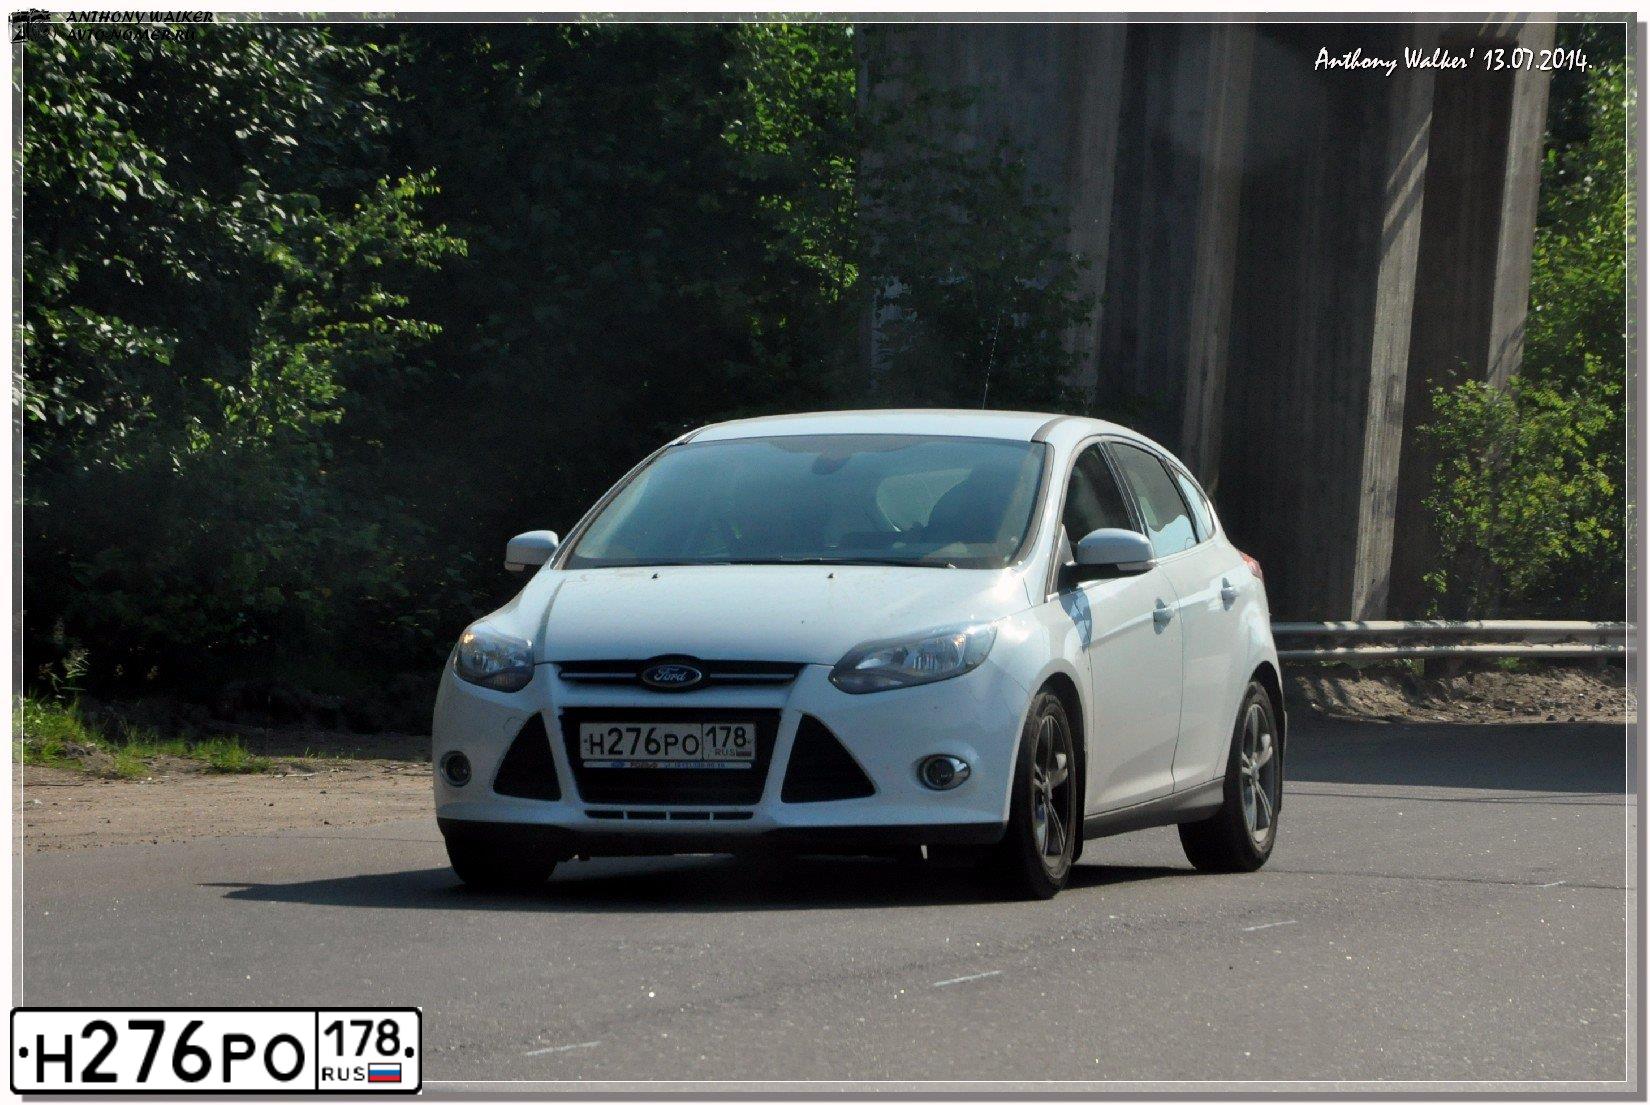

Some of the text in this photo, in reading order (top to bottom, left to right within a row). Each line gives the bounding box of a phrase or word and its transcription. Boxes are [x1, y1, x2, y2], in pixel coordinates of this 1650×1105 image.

[653, 665, 689, 682] Ford
[705, 725, 747, 748] 178
[714, 749, 736, 757] RUS
